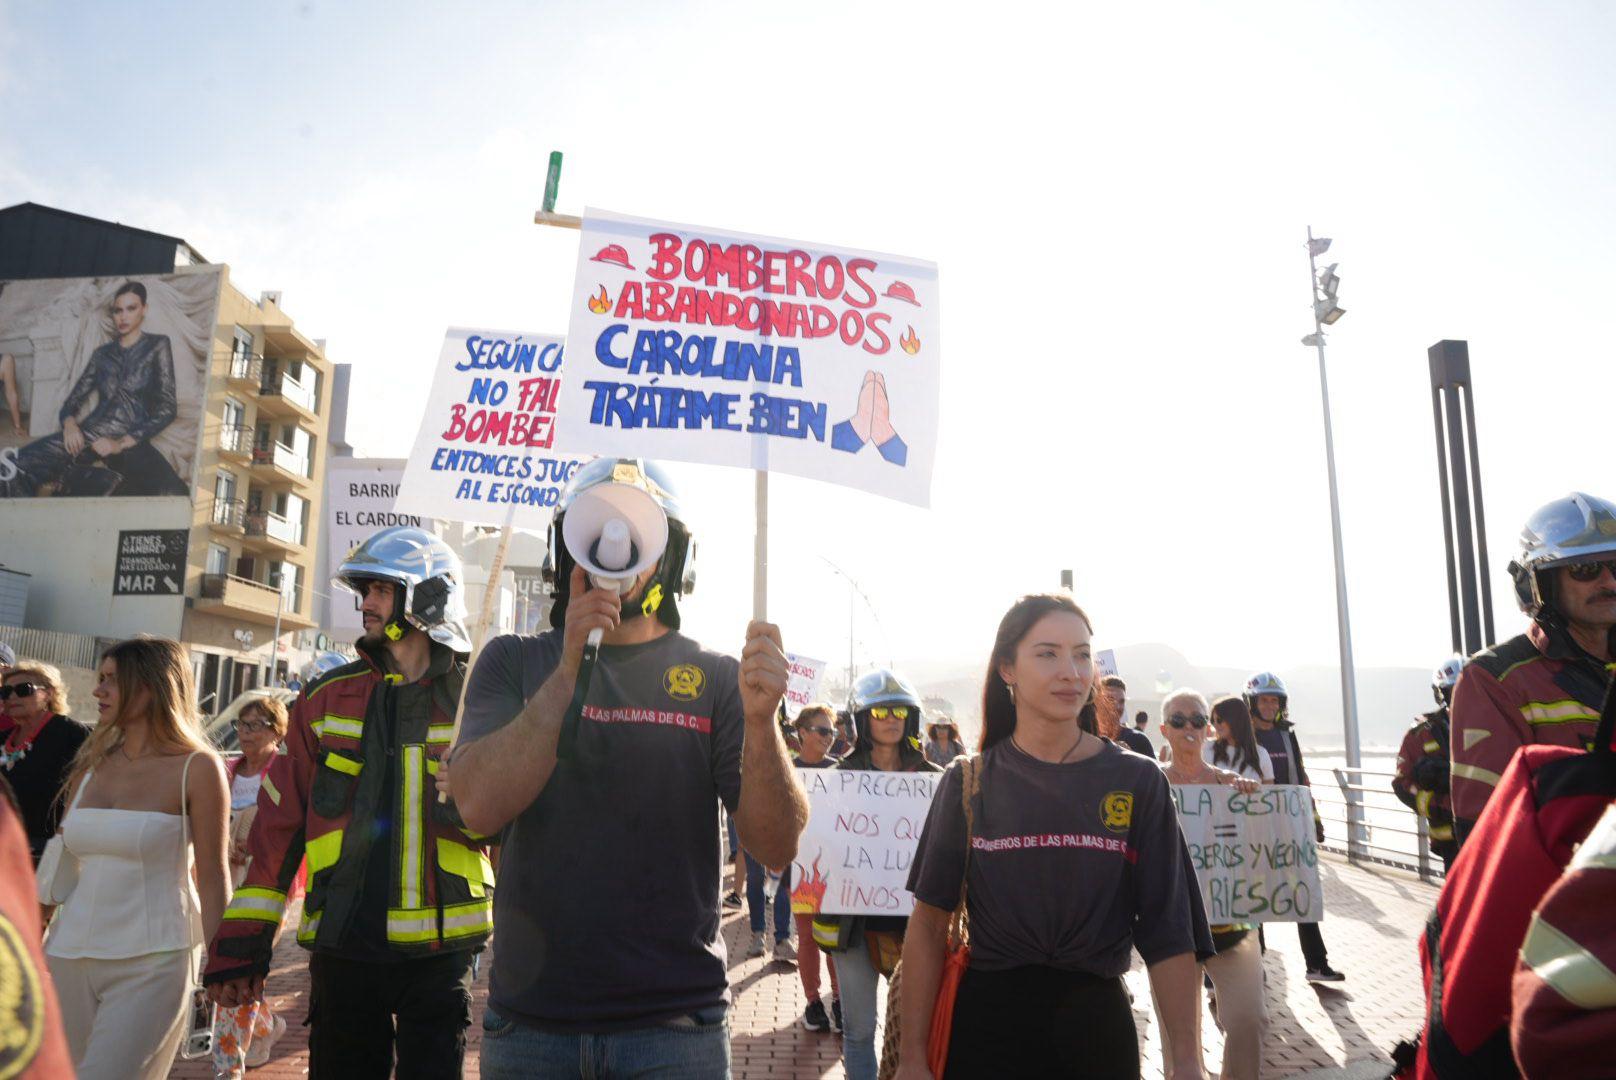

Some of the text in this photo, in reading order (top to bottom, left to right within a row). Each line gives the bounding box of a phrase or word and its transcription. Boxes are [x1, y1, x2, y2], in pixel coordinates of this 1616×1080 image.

[645, 232, 878, 309] BOMBEROS
[613, 280, 892, 355] ABANDONADOS
[454, 335, 538, 374] SEGÚN
[595, 323, 803, 387] CAROLINA
[467, 377, 509, 407] NO
[583, 377, 828, 443] TRÁTAME BIEN
[430, 447, 533, 479] ENTONCES
[455, 478, 482, 500] AL
[336, 511, 421, 528] EL CARDON
[118, 574, 156, 592] MAR
[589, 706, 610, 723] LAS
[611, 709, 656, 723] PALMAS
[658, 711, 674, 724] DE
[835, 812, 880, 837] NOS
[1023, 835, 1038, 848] DE
[1040, 834, 1061, 847] LAS
[1062, 833, 1104, 849] PALMAS
[1105, 838, 1120, 851] DE
[843, 845, 874, 870] LA
[1208, 876, 1311, 919] RIESGO
